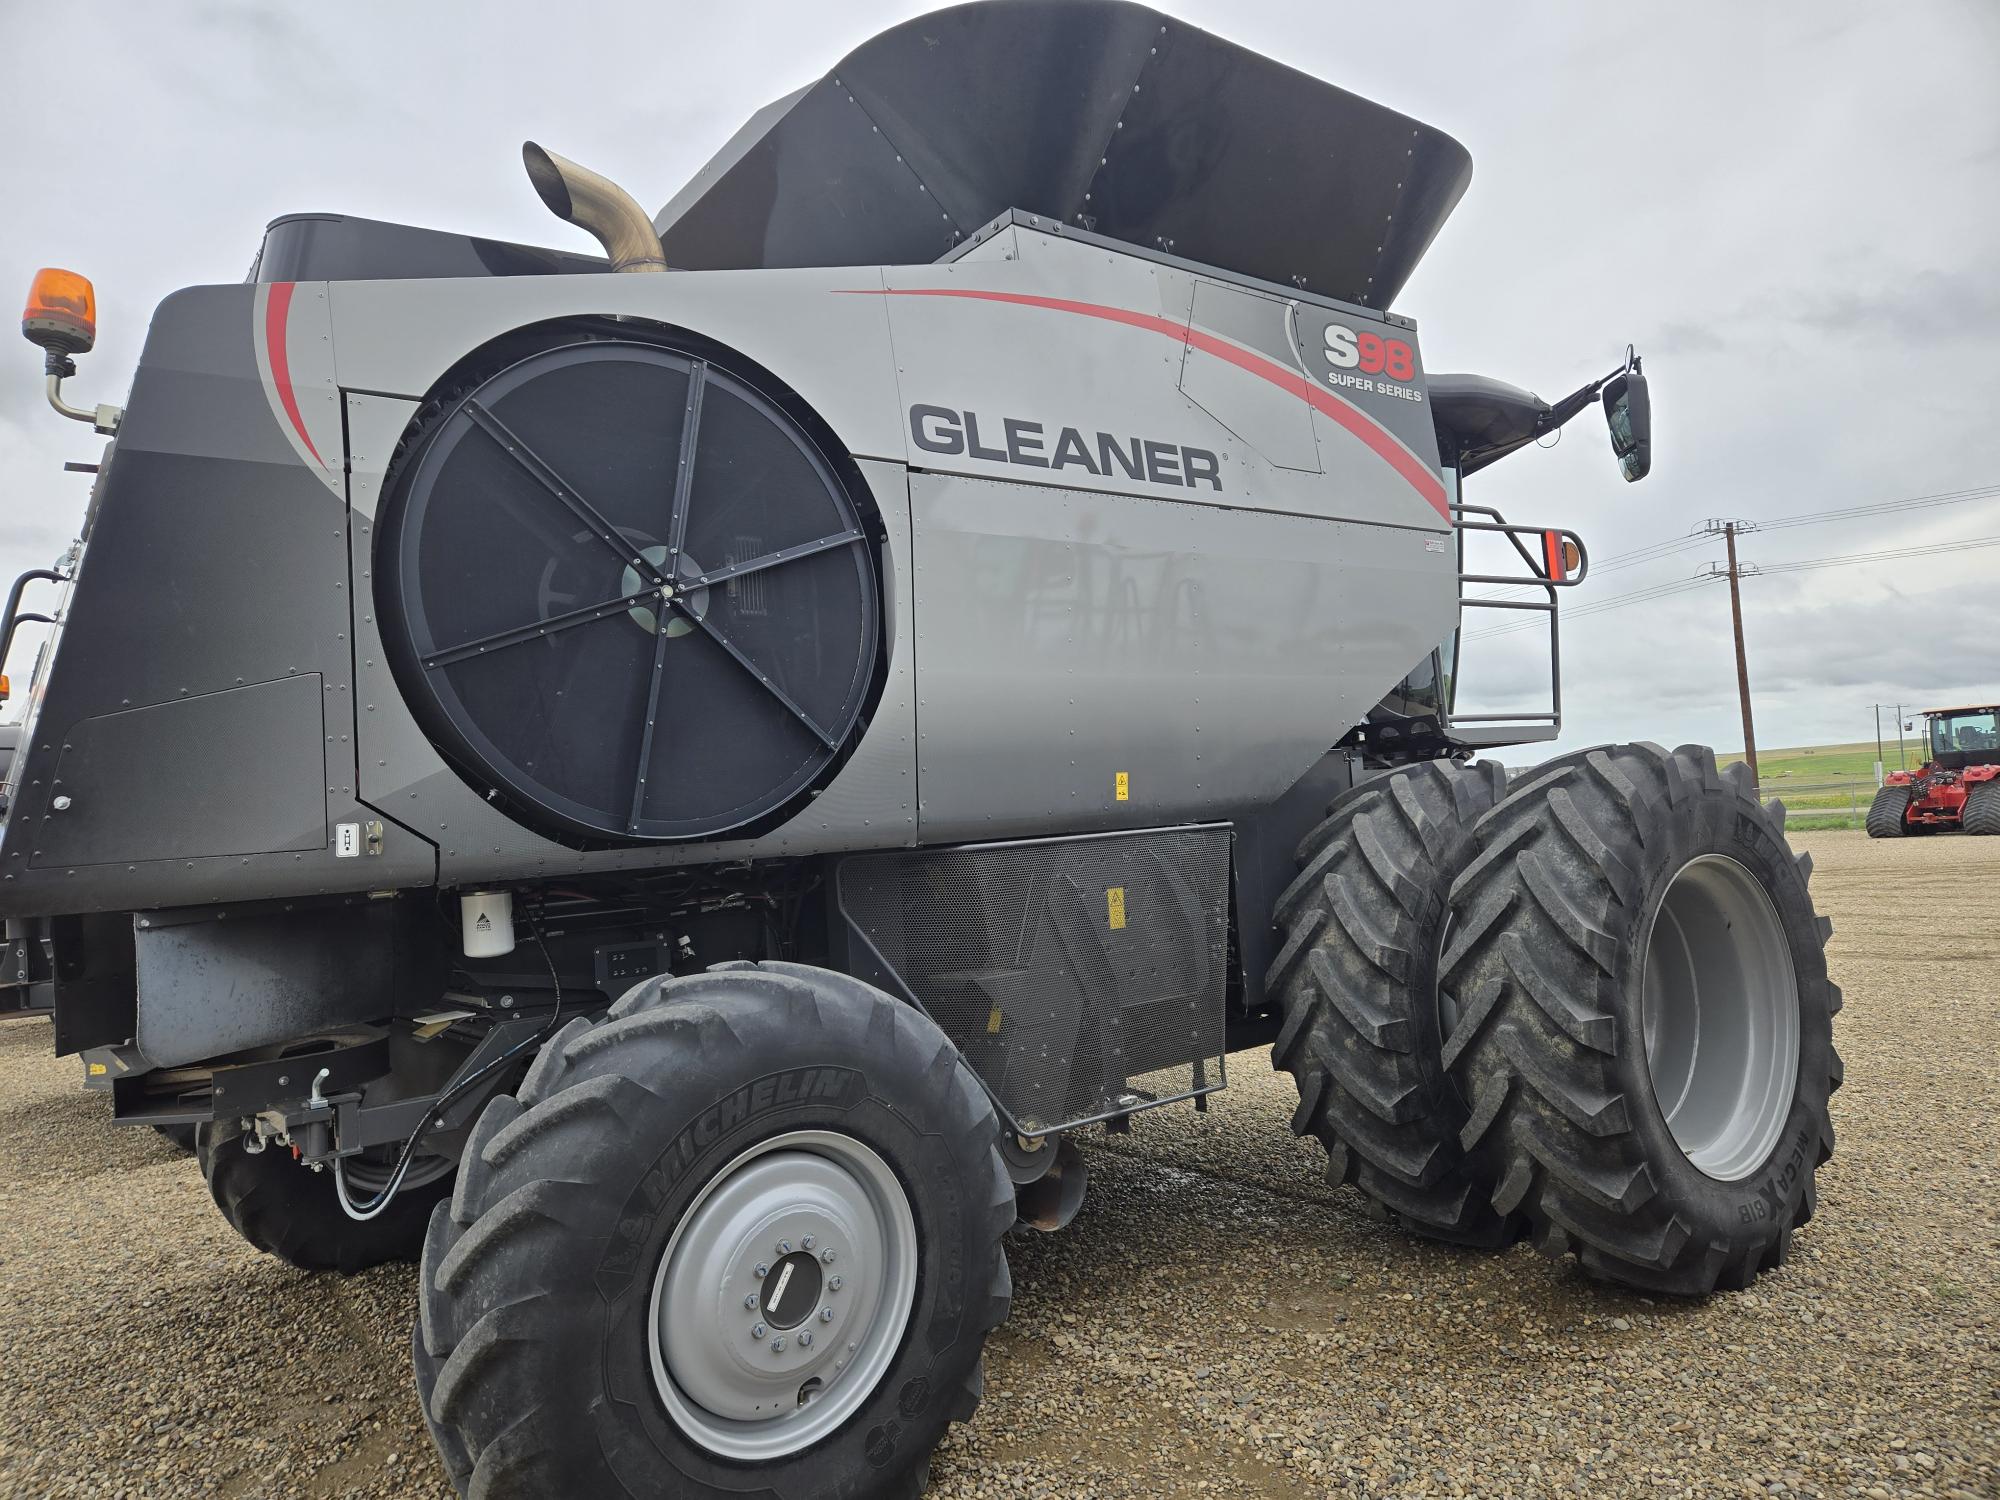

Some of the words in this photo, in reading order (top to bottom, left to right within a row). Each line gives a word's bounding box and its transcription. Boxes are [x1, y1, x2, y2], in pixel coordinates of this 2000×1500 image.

[1323, 322, 1416, 382] S98
[1328, 372, 1373, 391] SUPER
[1377, 382, 1421, 402] SERIES
[910, 403, 1223, 491] GLEANER
[640, 1067, 856, 1201] MICHELIN
